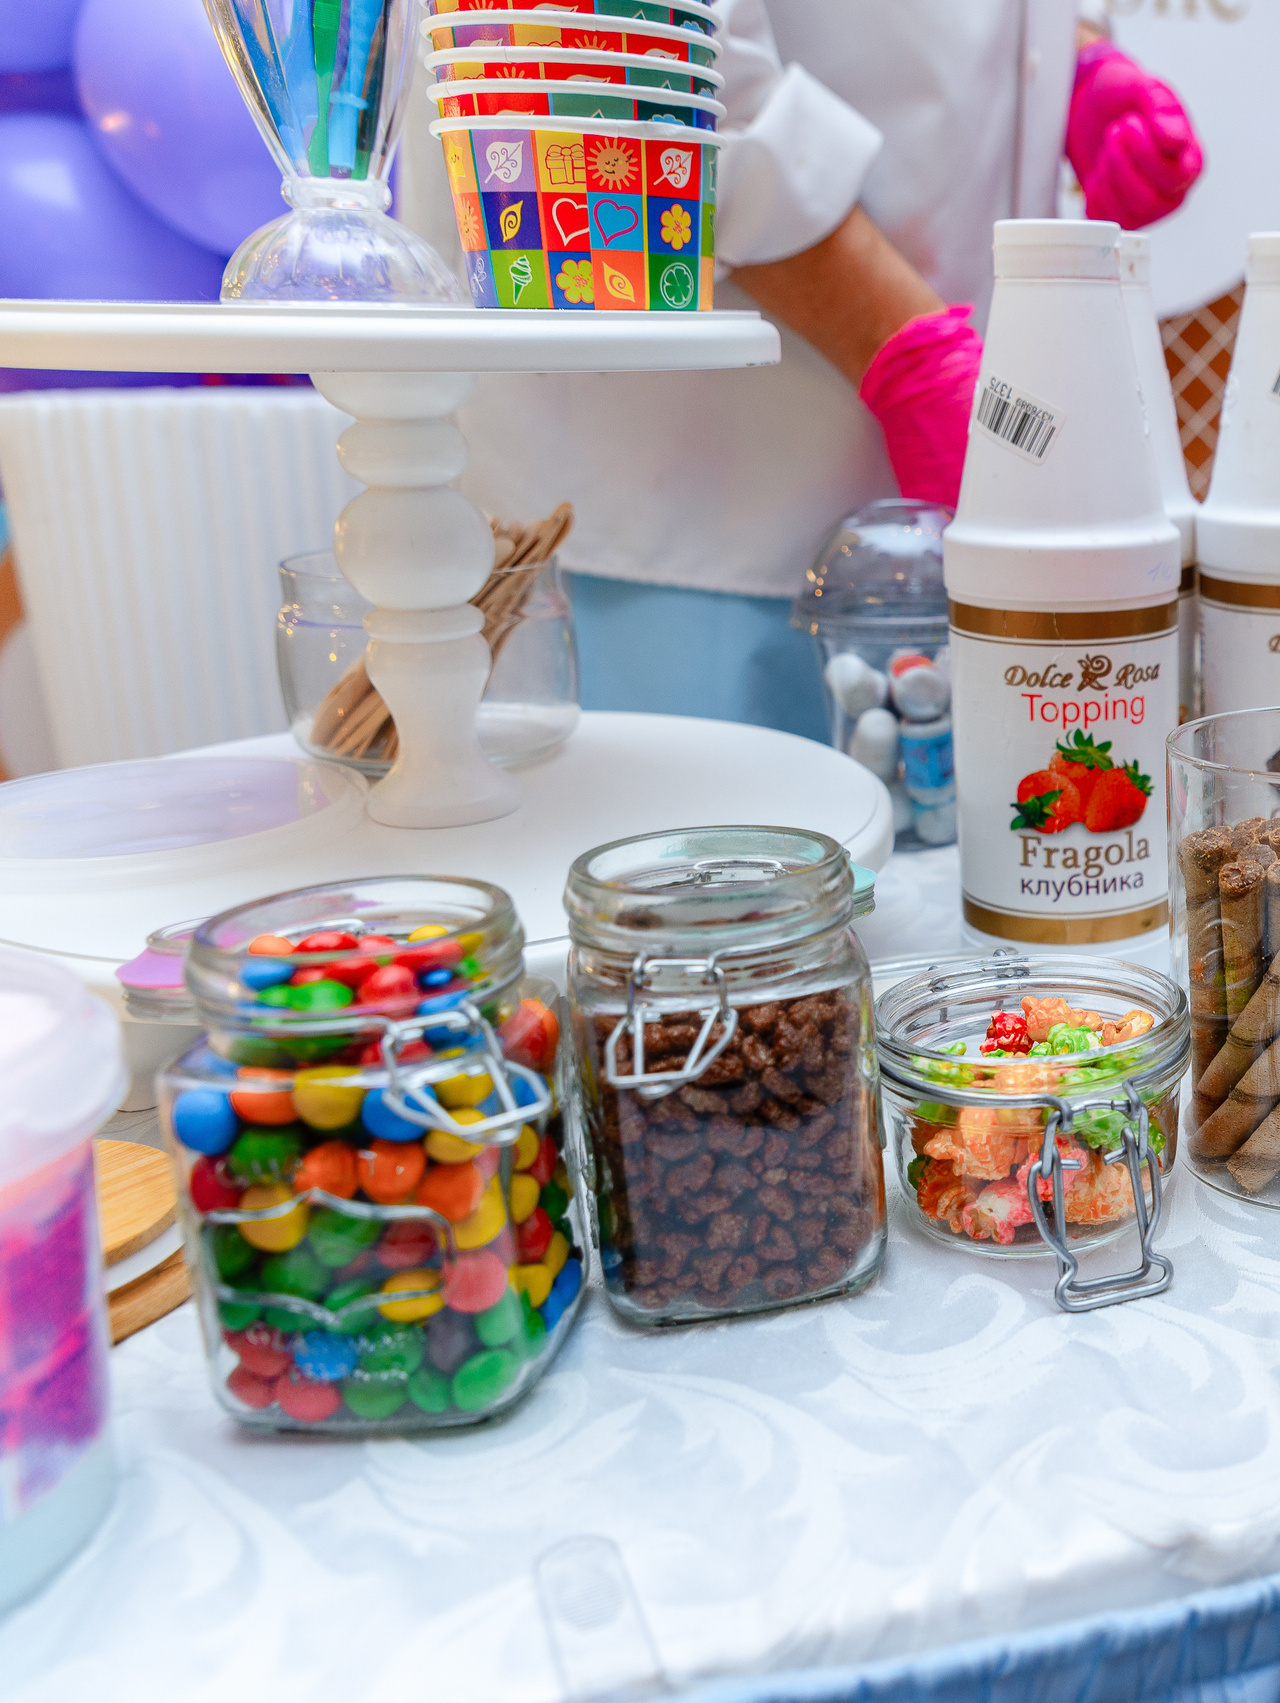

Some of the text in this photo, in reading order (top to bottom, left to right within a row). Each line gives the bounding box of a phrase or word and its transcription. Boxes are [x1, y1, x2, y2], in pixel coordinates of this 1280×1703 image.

[989, 376, 1013, 400] 1375
[1004, 663, 1161, 689] Dolce Rosa
[1021, 693, 1145, 730] Topping
[1020, 831, 1150, 878] Fragola
[1021, 871, 1144, 902] клубника
